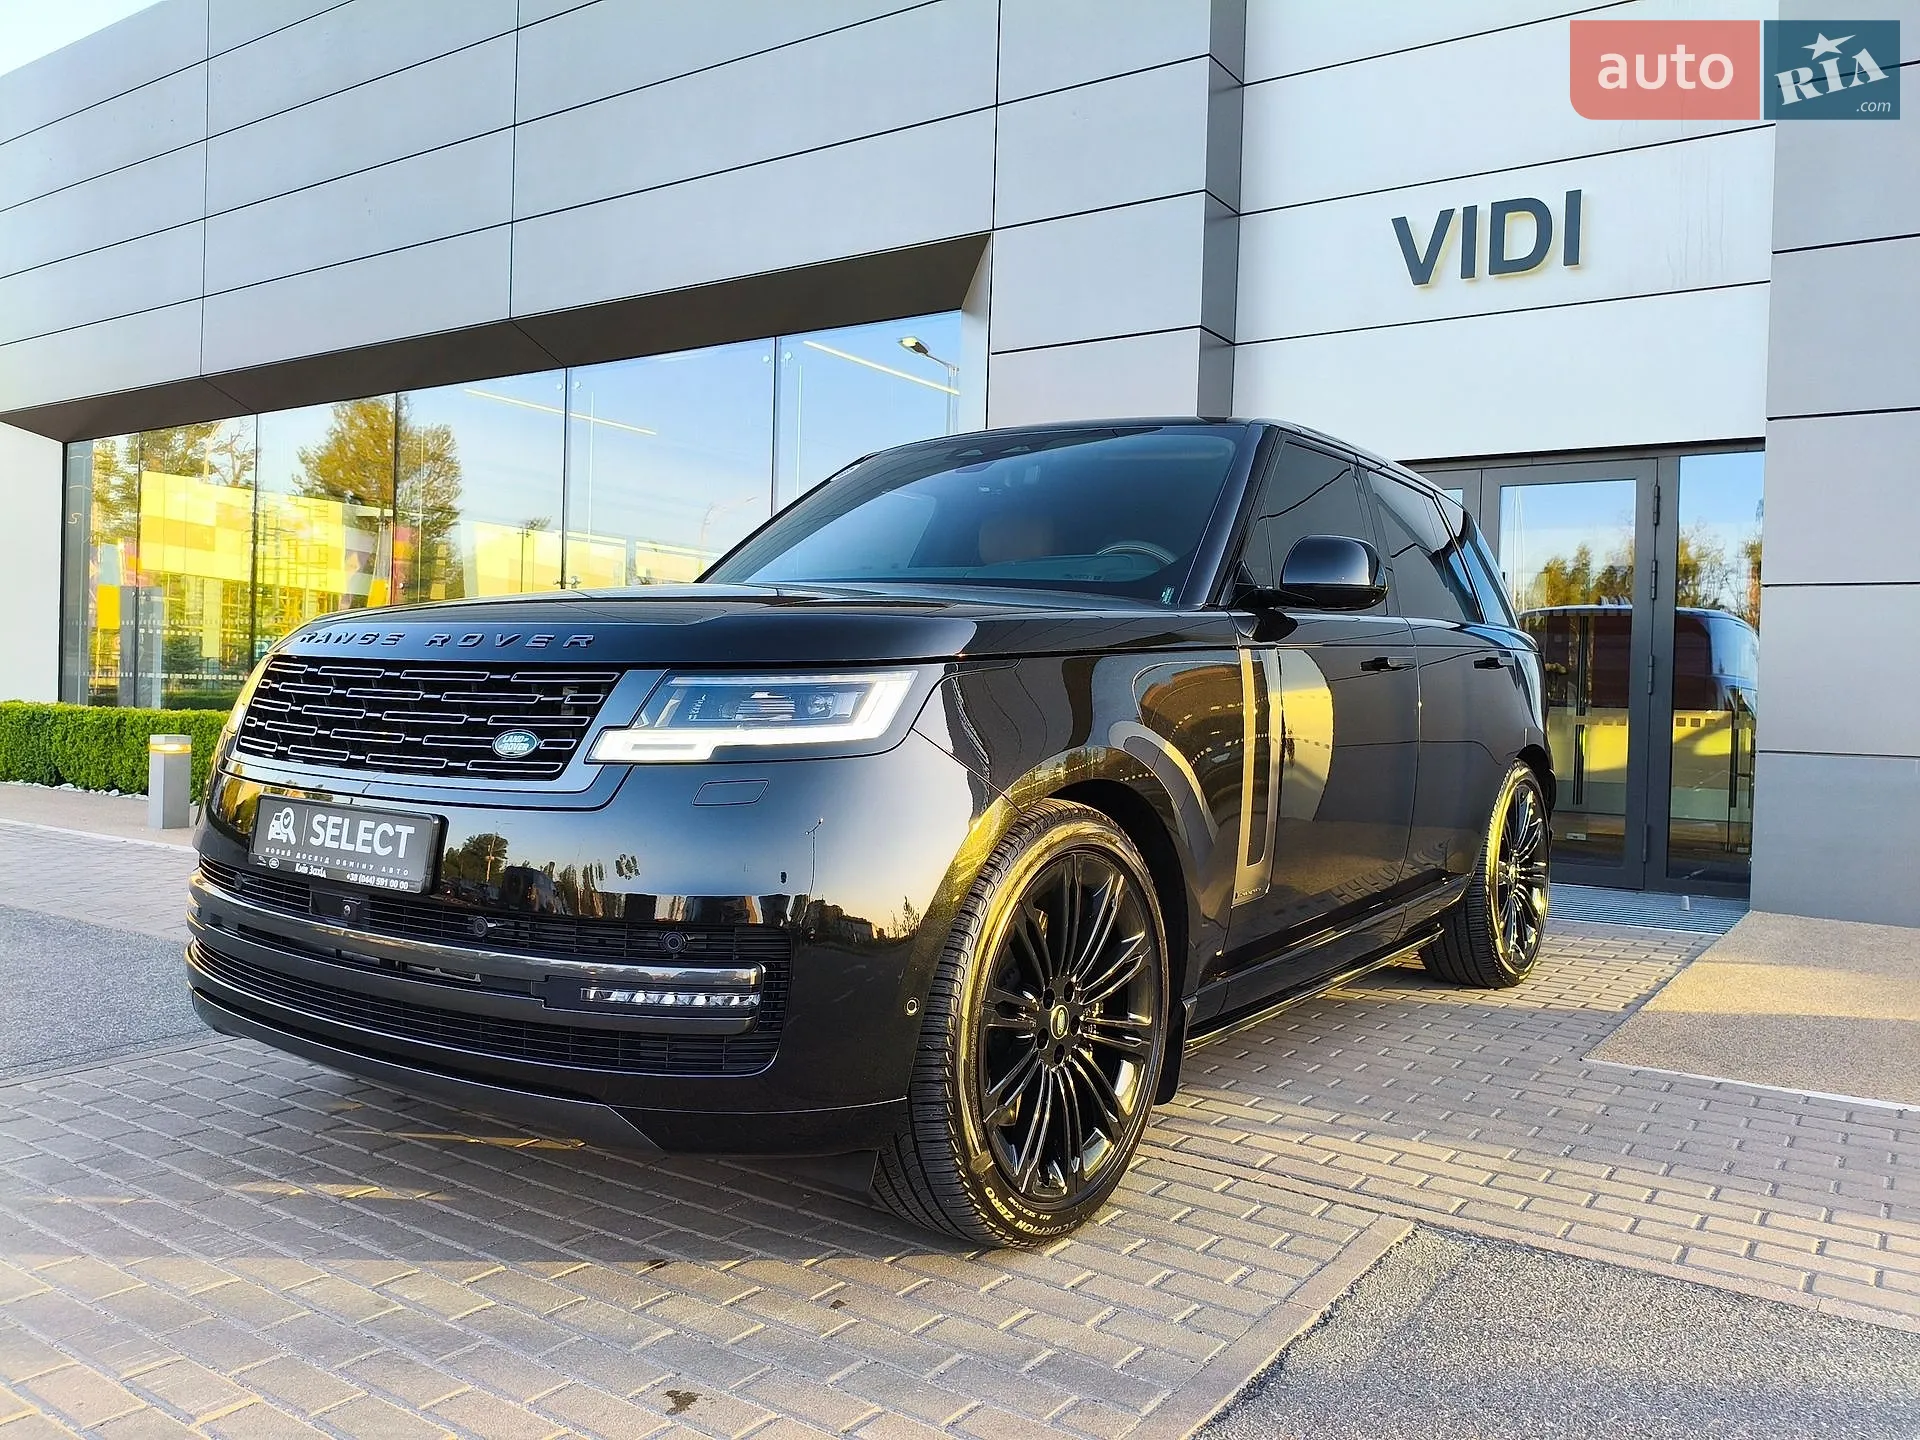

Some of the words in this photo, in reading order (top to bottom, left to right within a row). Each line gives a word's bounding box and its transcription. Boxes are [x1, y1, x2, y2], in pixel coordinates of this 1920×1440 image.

[1391, 189, 1582, 286] VIDI
[299, 632, 406, 646] RANGE
[424, 633, 595, 649] ROVER
[309, 813, 415, 859] SELECT
[381, 866, 409, 876] АВТО
[389, 879, 399, 889] 00
[399, 880, 409, 890] 00
[984, 1186, 1016, 1221] ZERO
[1014, 1219, 1078, 1236] SCORPION
